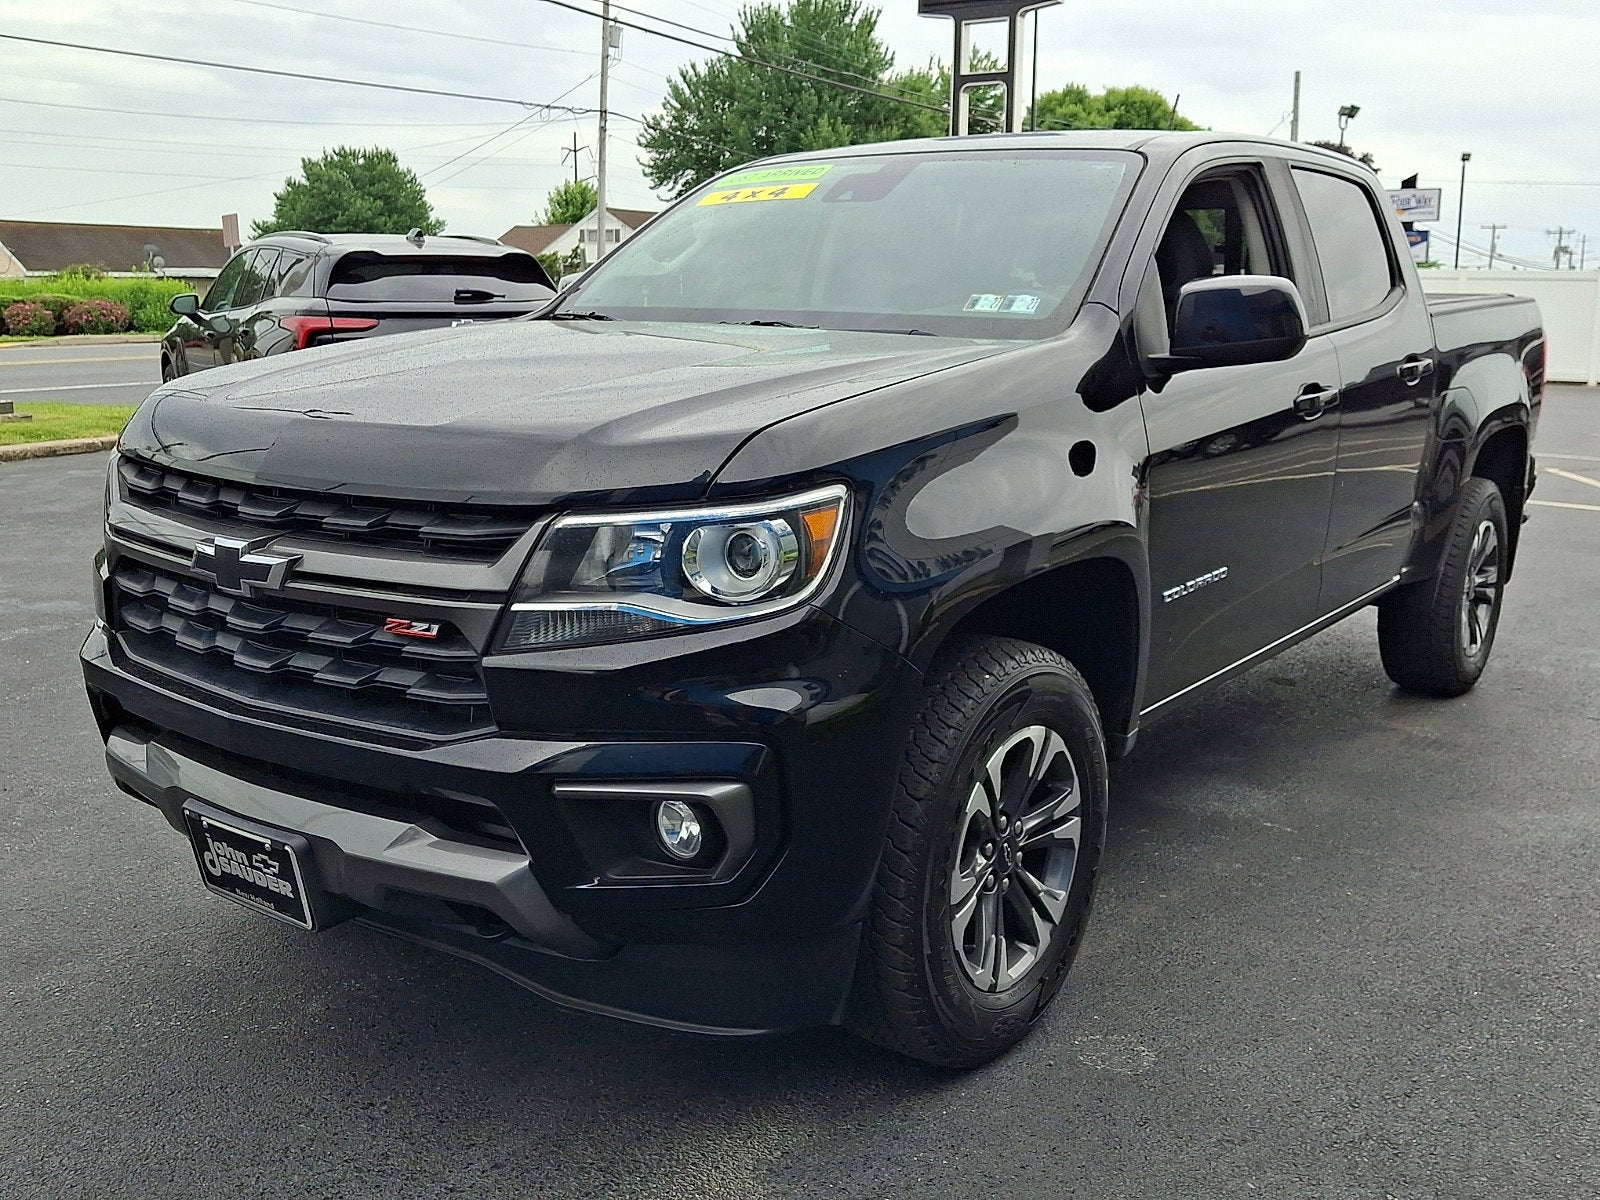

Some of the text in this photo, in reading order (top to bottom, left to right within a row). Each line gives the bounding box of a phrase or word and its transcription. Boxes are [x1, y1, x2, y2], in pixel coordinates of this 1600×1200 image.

[1162, 566, 1228, 603] COLORADO
[383, 617, 440, 639] Z71
[218, 856, 295, 900] SAUDER
